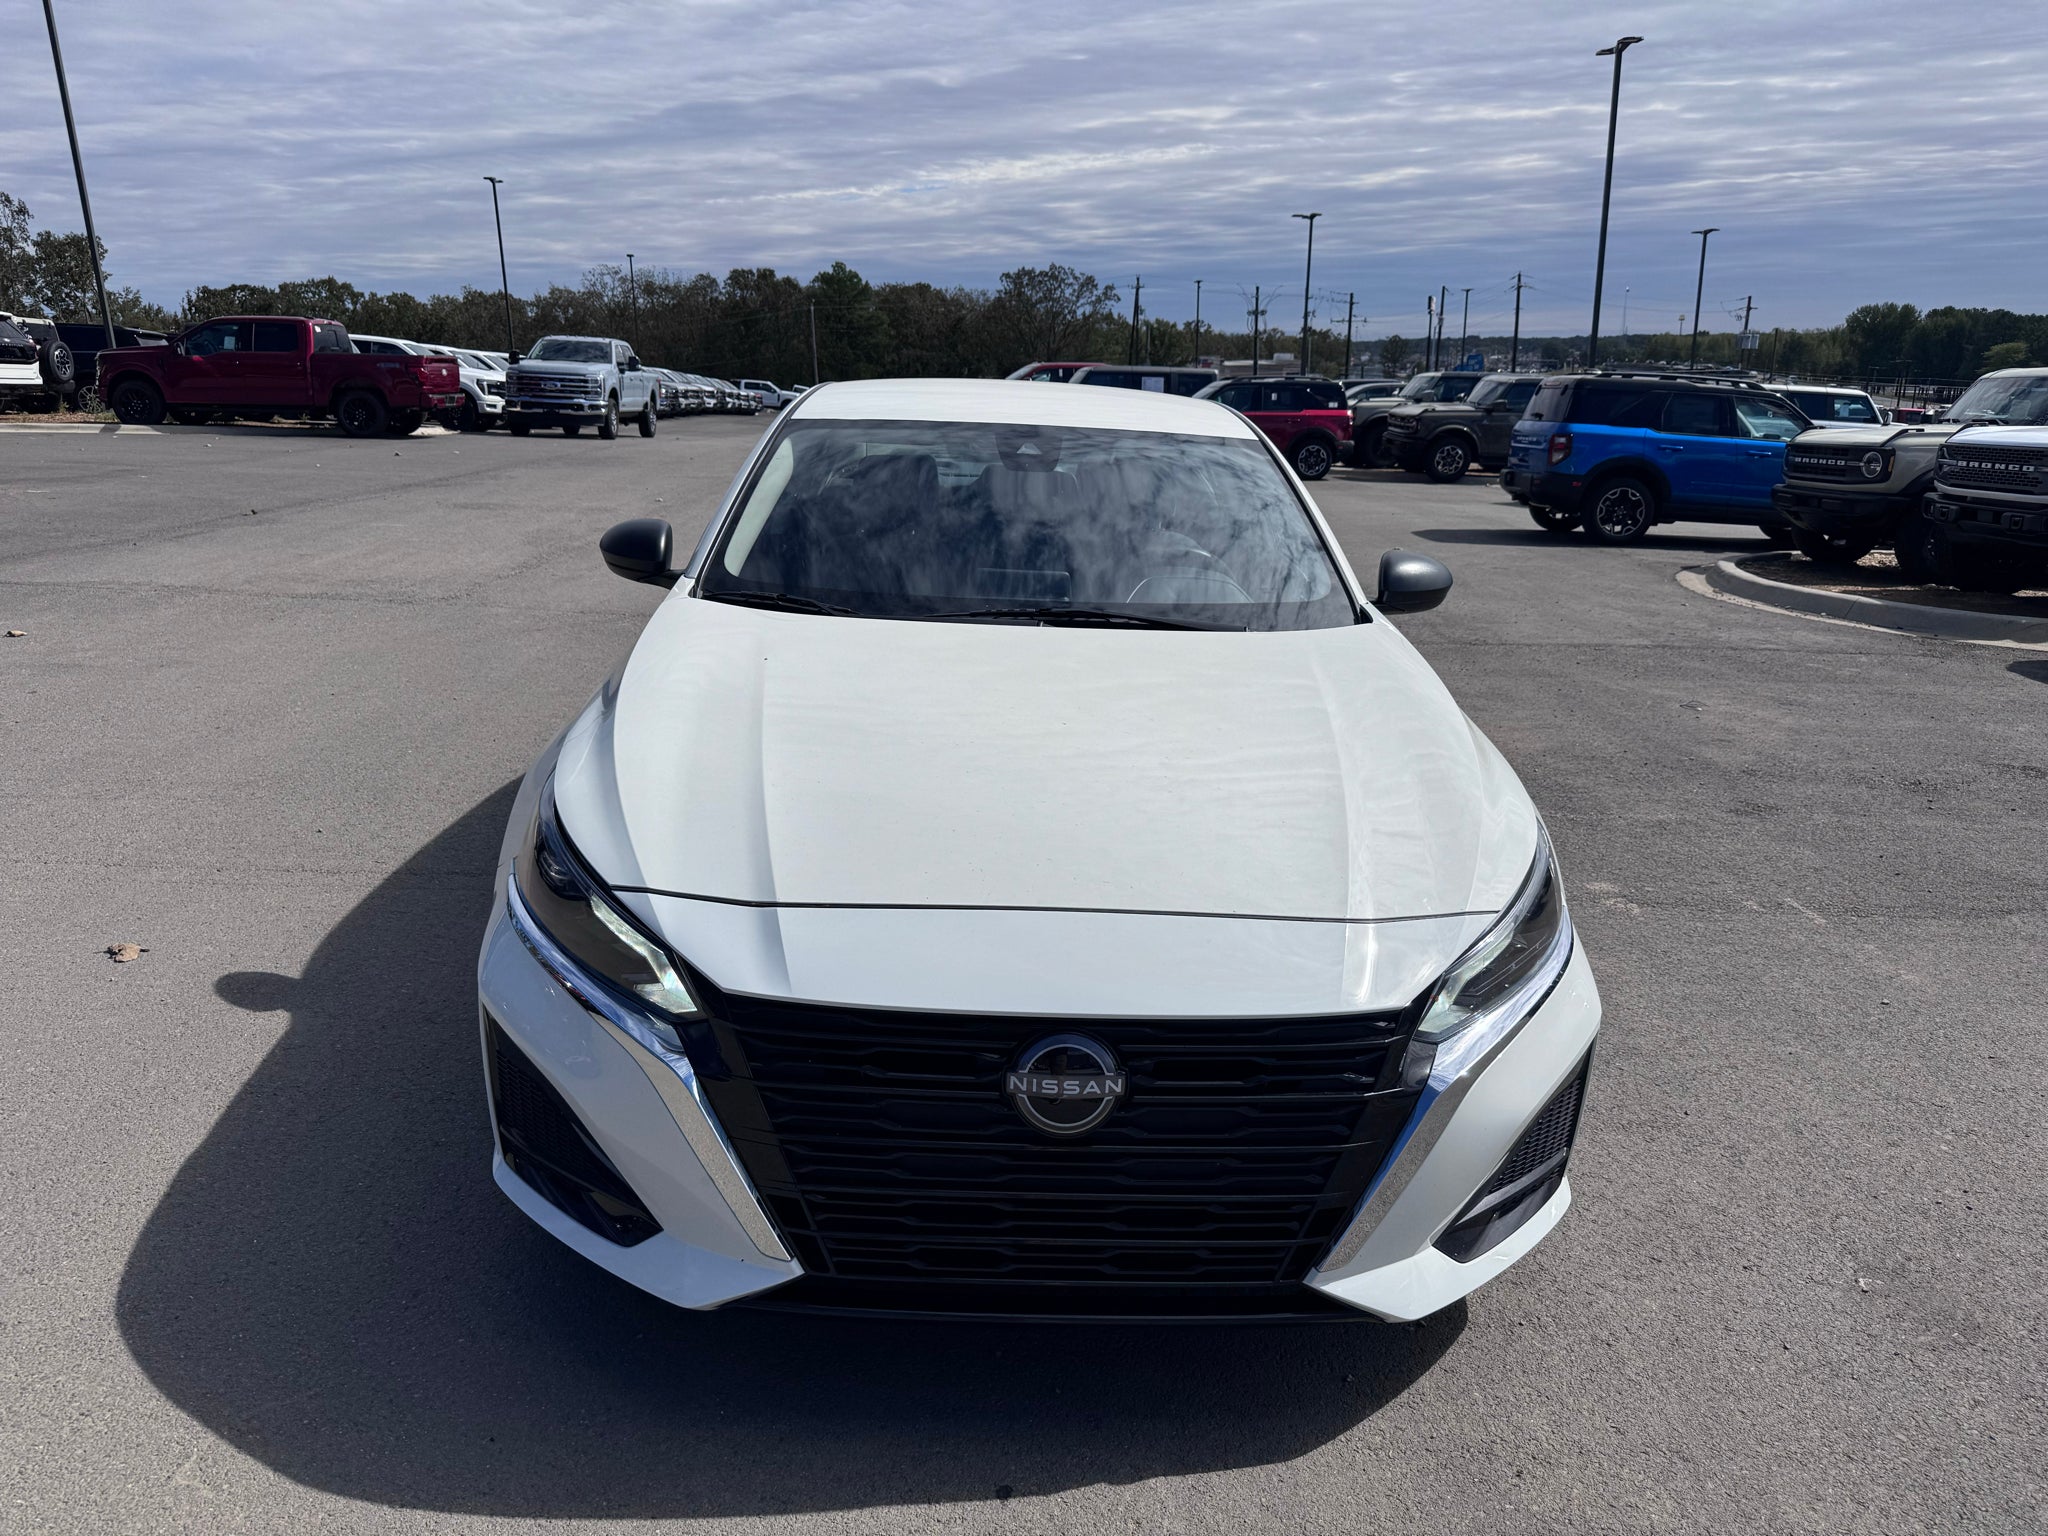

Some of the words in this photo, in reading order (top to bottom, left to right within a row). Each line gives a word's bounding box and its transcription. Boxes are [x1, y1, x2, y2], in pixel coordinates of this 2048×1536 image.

[1795, 457, 1845, 466] BRONCO
[1957, 460, 2035, 472] BRONCO
[1009, 1075, 1122, 1095] NISSAN
